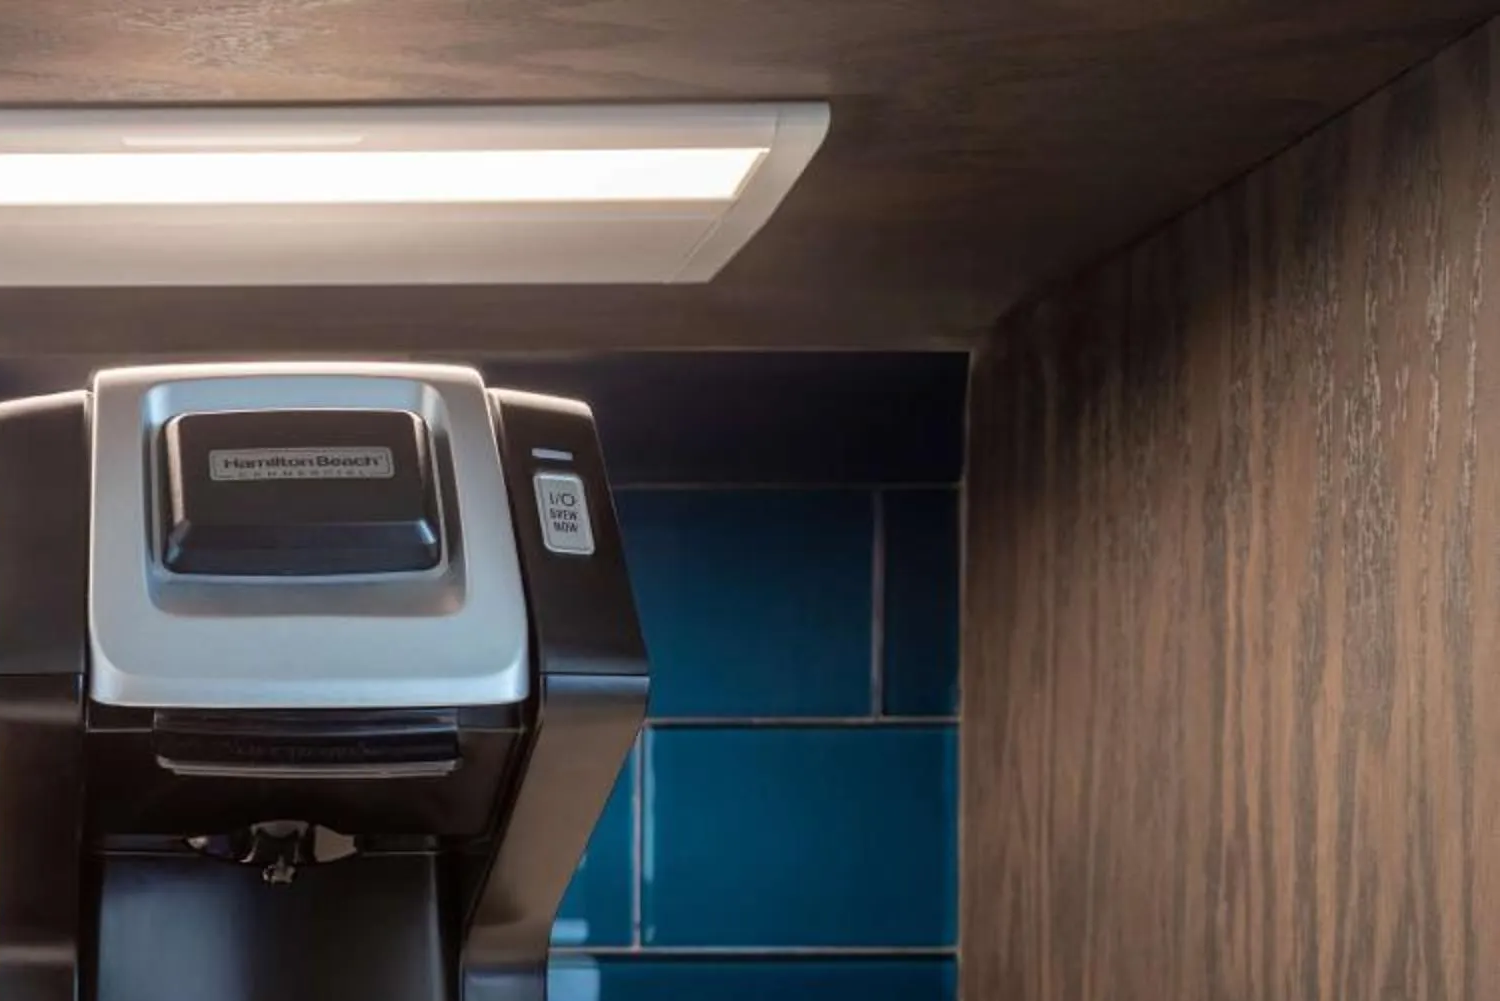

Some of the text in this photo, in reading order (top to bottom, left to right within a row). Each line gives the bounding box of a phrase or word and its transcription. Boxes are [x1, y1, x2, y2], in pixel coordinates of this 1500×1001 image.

[224, 454, 379, 469] Hamilton Beach
[549, 507, 578, 521] BREW
[553, 520, 578, 533] NOW
